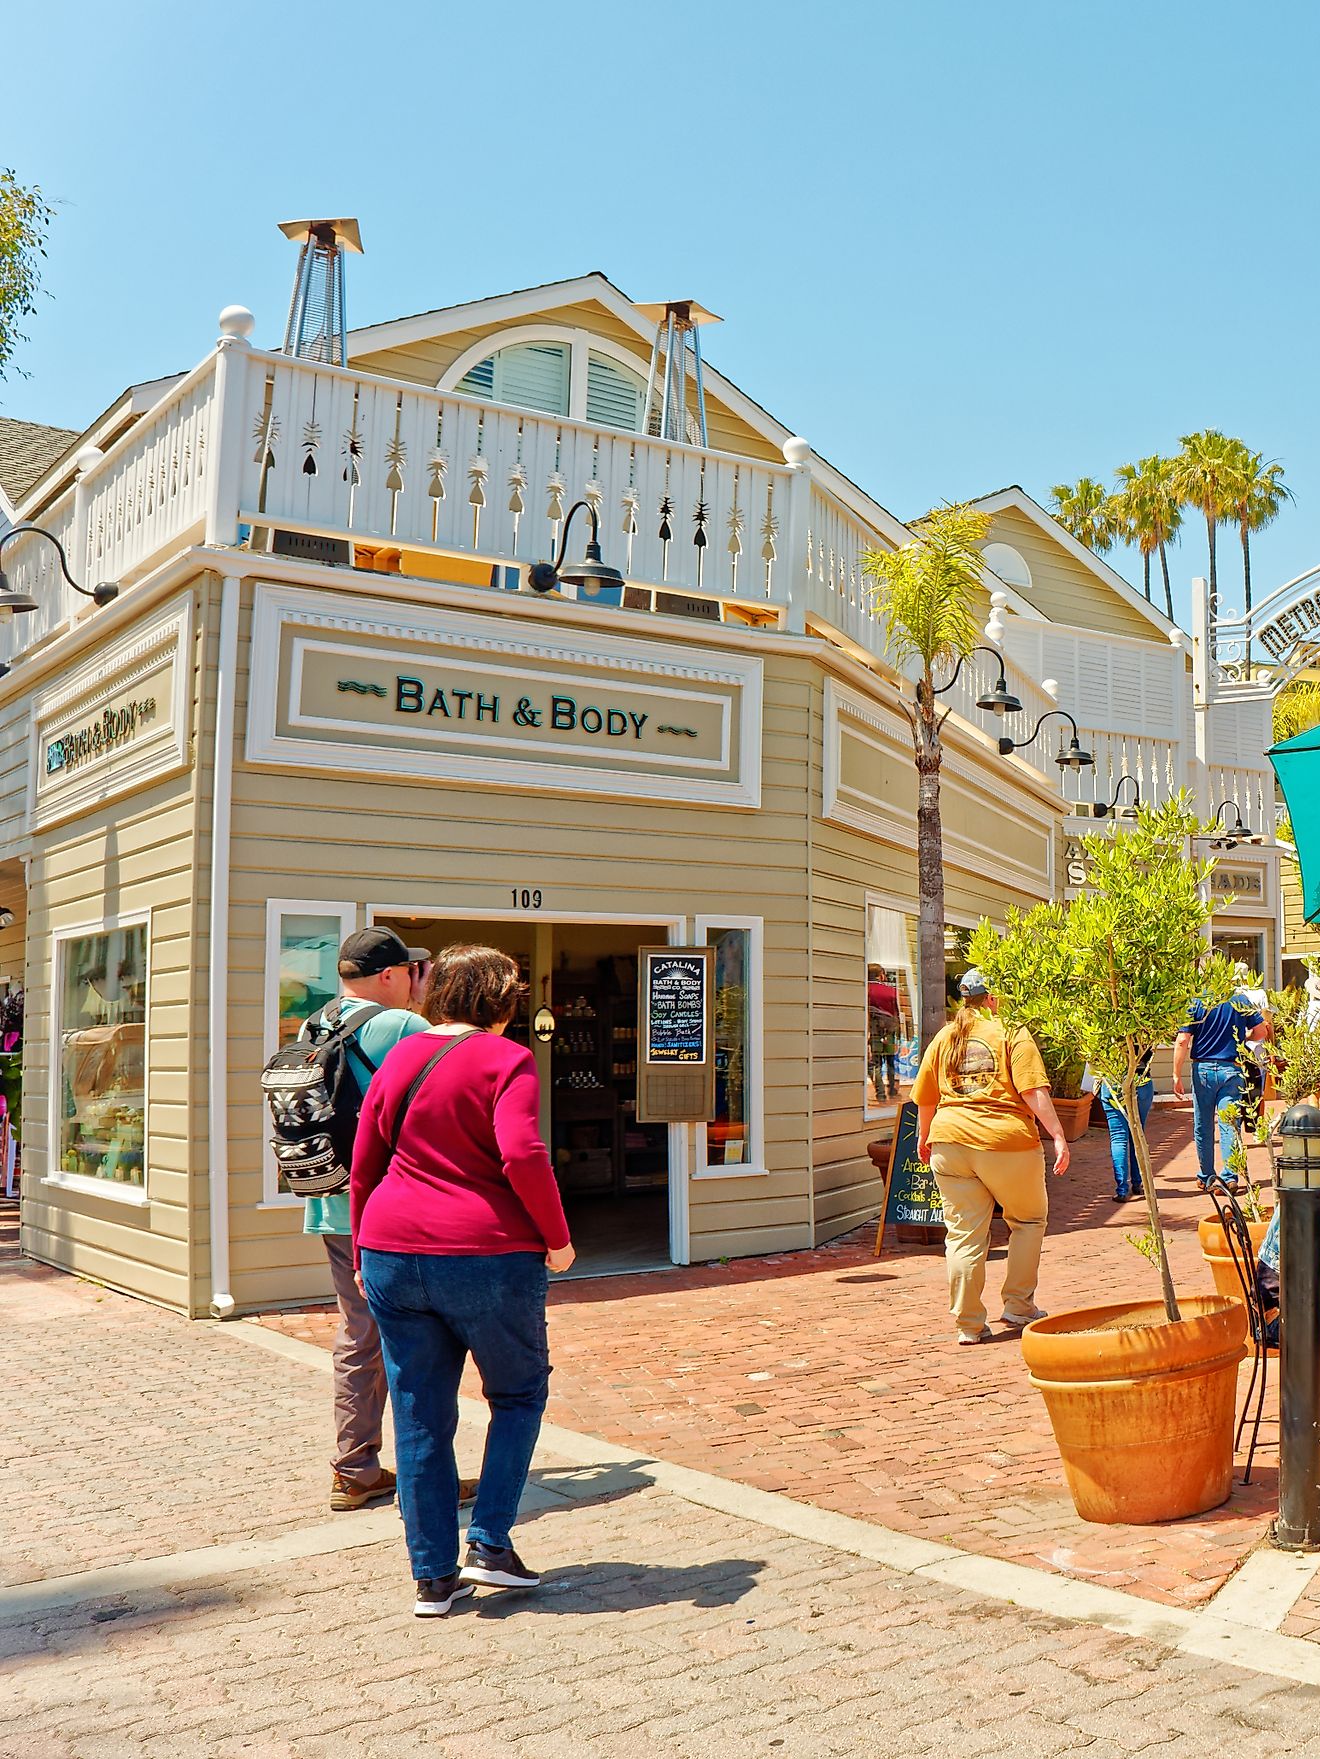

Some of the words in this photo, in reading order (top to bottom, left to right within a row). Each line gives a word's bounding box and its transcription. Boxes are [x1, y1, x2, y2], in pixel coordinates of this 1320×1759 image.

[396, 674, 500, 723] BATH
[512, 695, 544, 728] &
[551, 694, 649, 740] BODY
[62, 728, 92, 768] BATH
[103, 699, 139, 745] BODY
[511, 888, 542, 909] 109
[654, 961, 700, 975] CATALINA
[657, 1001, 676, 1010] BATH
[677, 1000, 701, 1009] BOMBS
[678, 1052, 699, 1060] GIFTS
[911, 1174, 929, 1190] Bar
